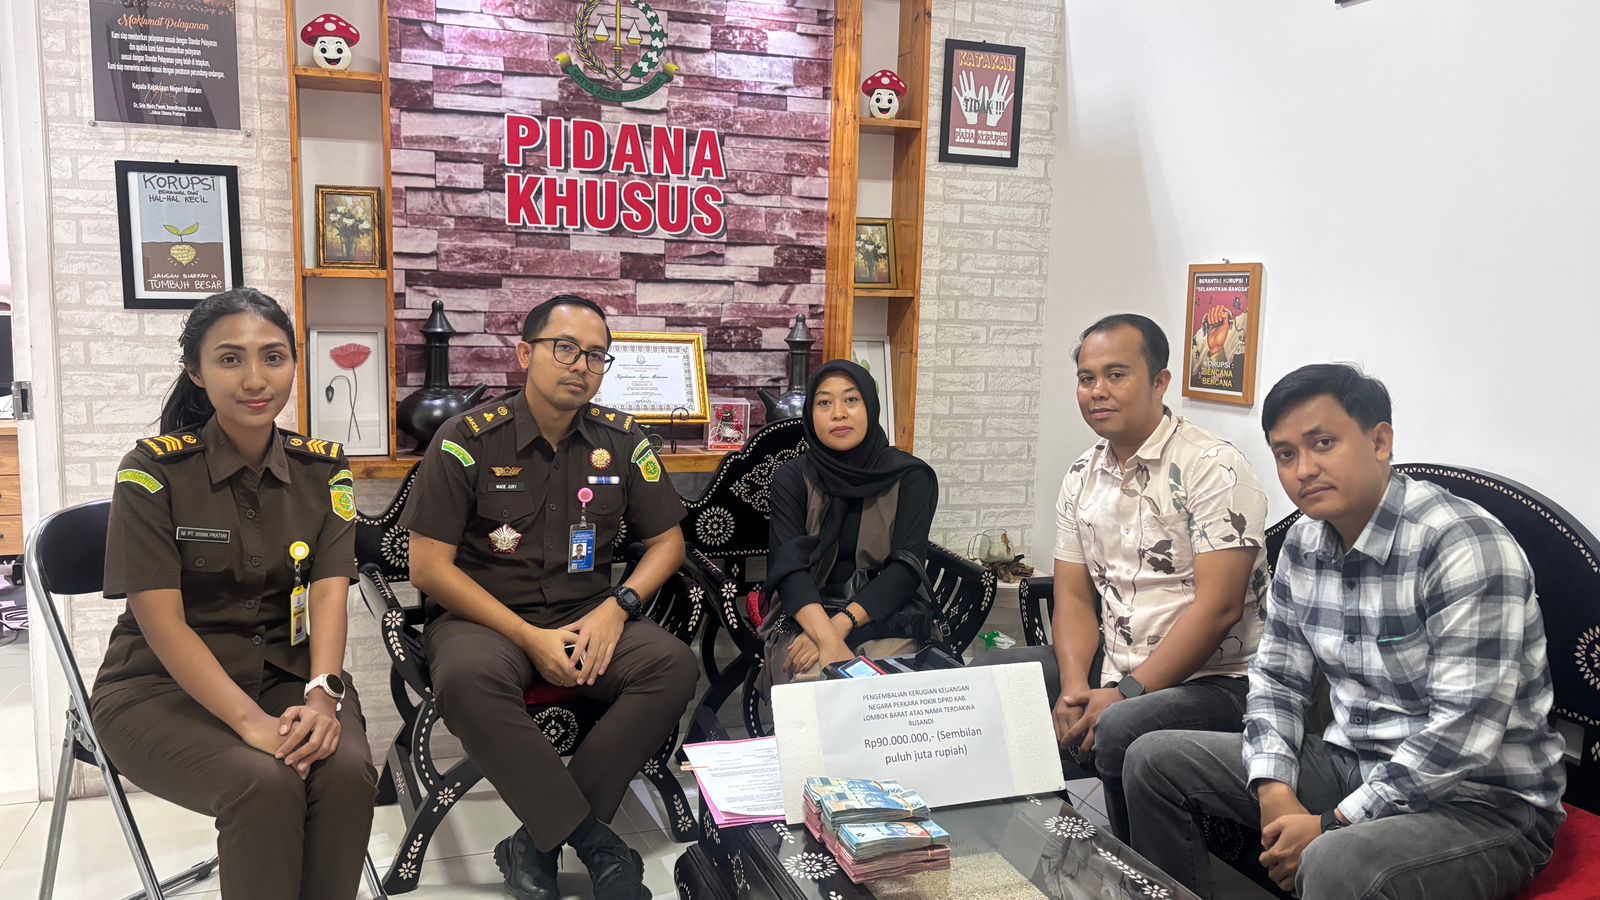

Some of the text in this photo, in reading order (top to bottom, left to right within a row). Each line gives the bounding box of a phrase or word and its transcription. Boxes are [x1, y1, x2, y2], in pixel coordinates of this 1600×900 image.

[117, 13, 209, 32] Maklumat Pelayanan
[111, 31, 120, 39] Kami
[147, 34, 164, 43] pelayanan
[176, 36, 187, 46] dengan
[188, 37, 200, 45] Standar
[200, 38, 217, 48] Pelayanan
[136, 44, 147, 52] apabila
[165, 46, 184, 54] memberikan
[185, 47, 201, 56] pelayanan
[133, 54, 144, 63] dengan
[145, 54, 157, 62] Standar
[158, 55, 174, 65] Pelayanan
[959, 51, 1015, 72] KATAKAN
[107, 62, 116, 70] Kami
[163, 66, 174, 75] dengan
[132, 82, 202, 94] Kepala Kejaksaan Negeri Mataram
[571, 69, 665, 100] SATYA ADHI WICAKSANA
[963, 96, 992, 115] TIDAK
[955, 127, 975, 143] PADA
[505, 113, 727, 180] PIDANA
[149, 194, 180, 203] HAL-HAL
[505, 173, 726, 236] KHUSUS
[147, 279, 223, 290] TUMBUH BESAR
[862, 685, 970, 701] PENGEMBALIAN KERUGIAN KEUANGAN
[868, 702, 893, 711] NEGARA
[893, 699, 919, 708] PERKARA
[937, 696, 954, 704] DPRD
[954, 694, 967, 702] KAB.
[863, 704, 976, 722] LOMBOK BARAT ATAS NAMA TERDAKWA
[908, 718, 935, 726] RUSANDI
[864, 726, 983, 750] Rp90.000.000,- (Sembilan
[885, 743, 968, 765] puluh juta rupiah)
